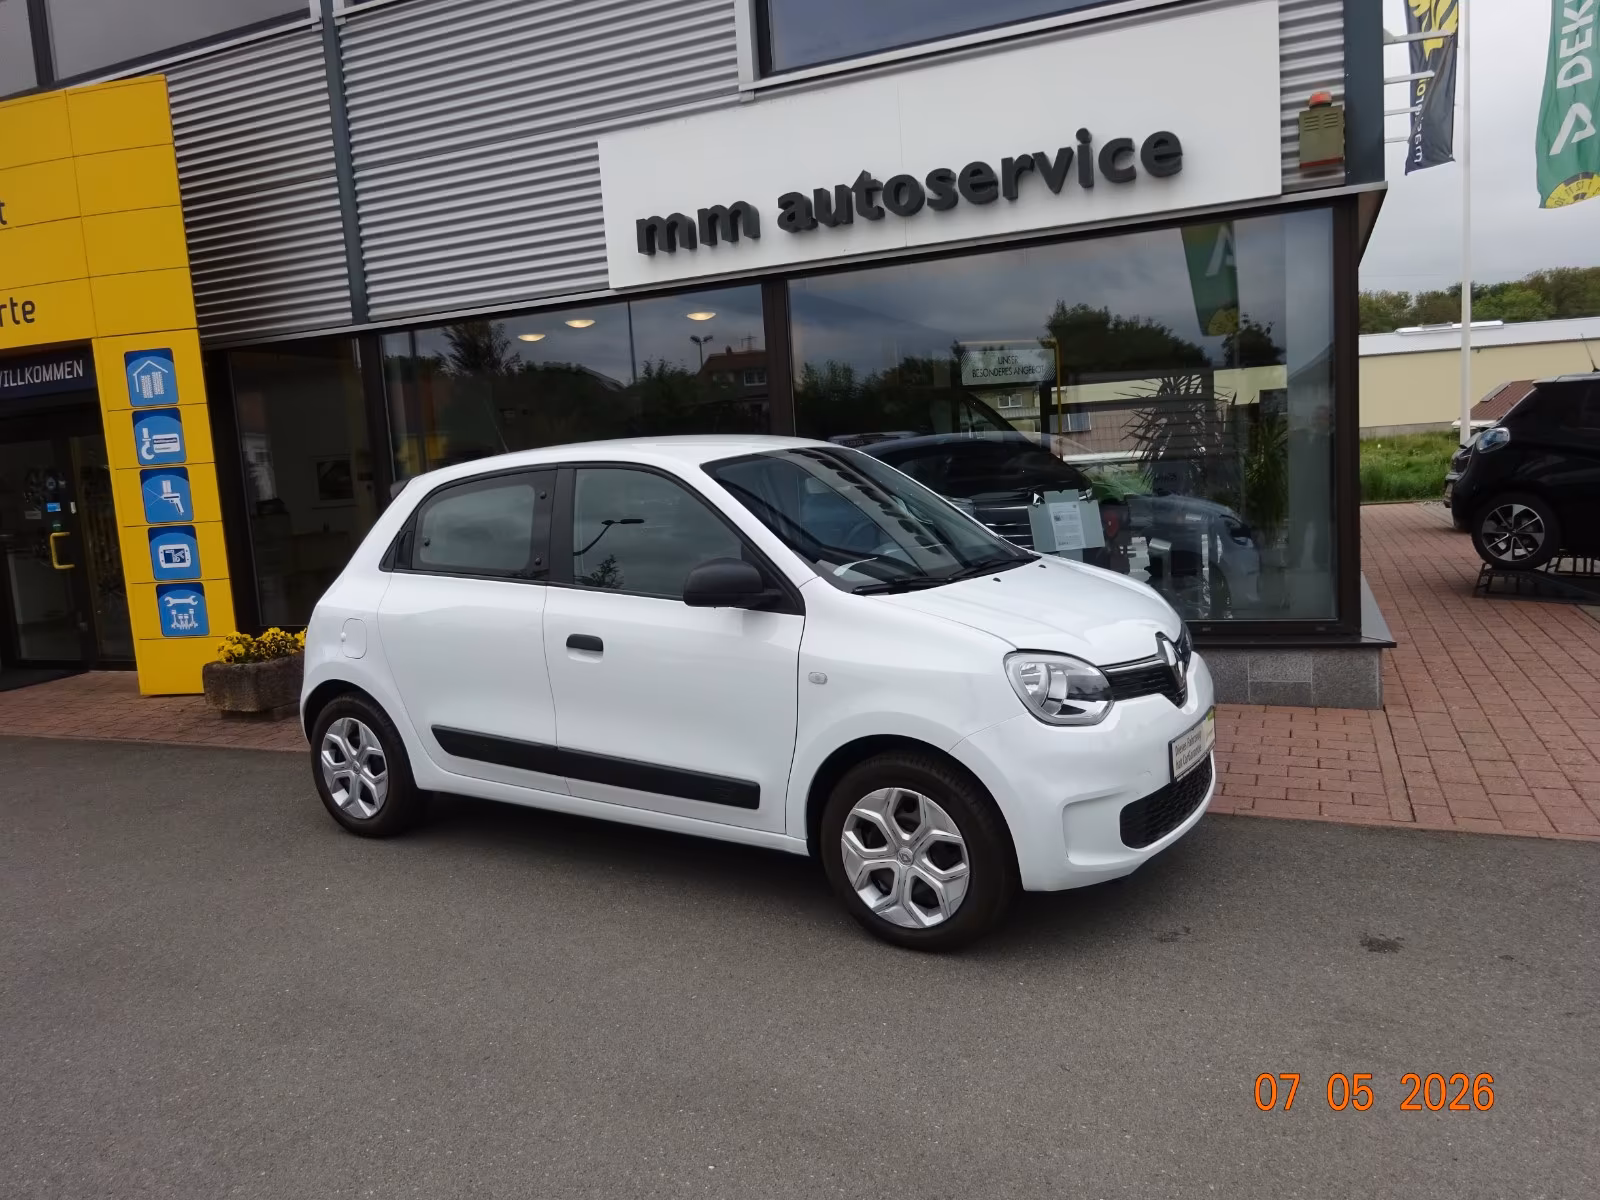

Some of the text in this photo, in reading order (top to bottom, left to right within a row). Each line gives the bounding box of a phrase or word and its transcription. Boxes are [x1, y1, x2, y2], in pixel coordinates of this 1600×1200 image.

[1556, 0, 1593, 88] DEK
[636, 127, 1183, 256] mm autoservice
[972, 364, 1045, 378] BESONDERES ANGEBOT
[998, 355, 1019, 365] UNSER
